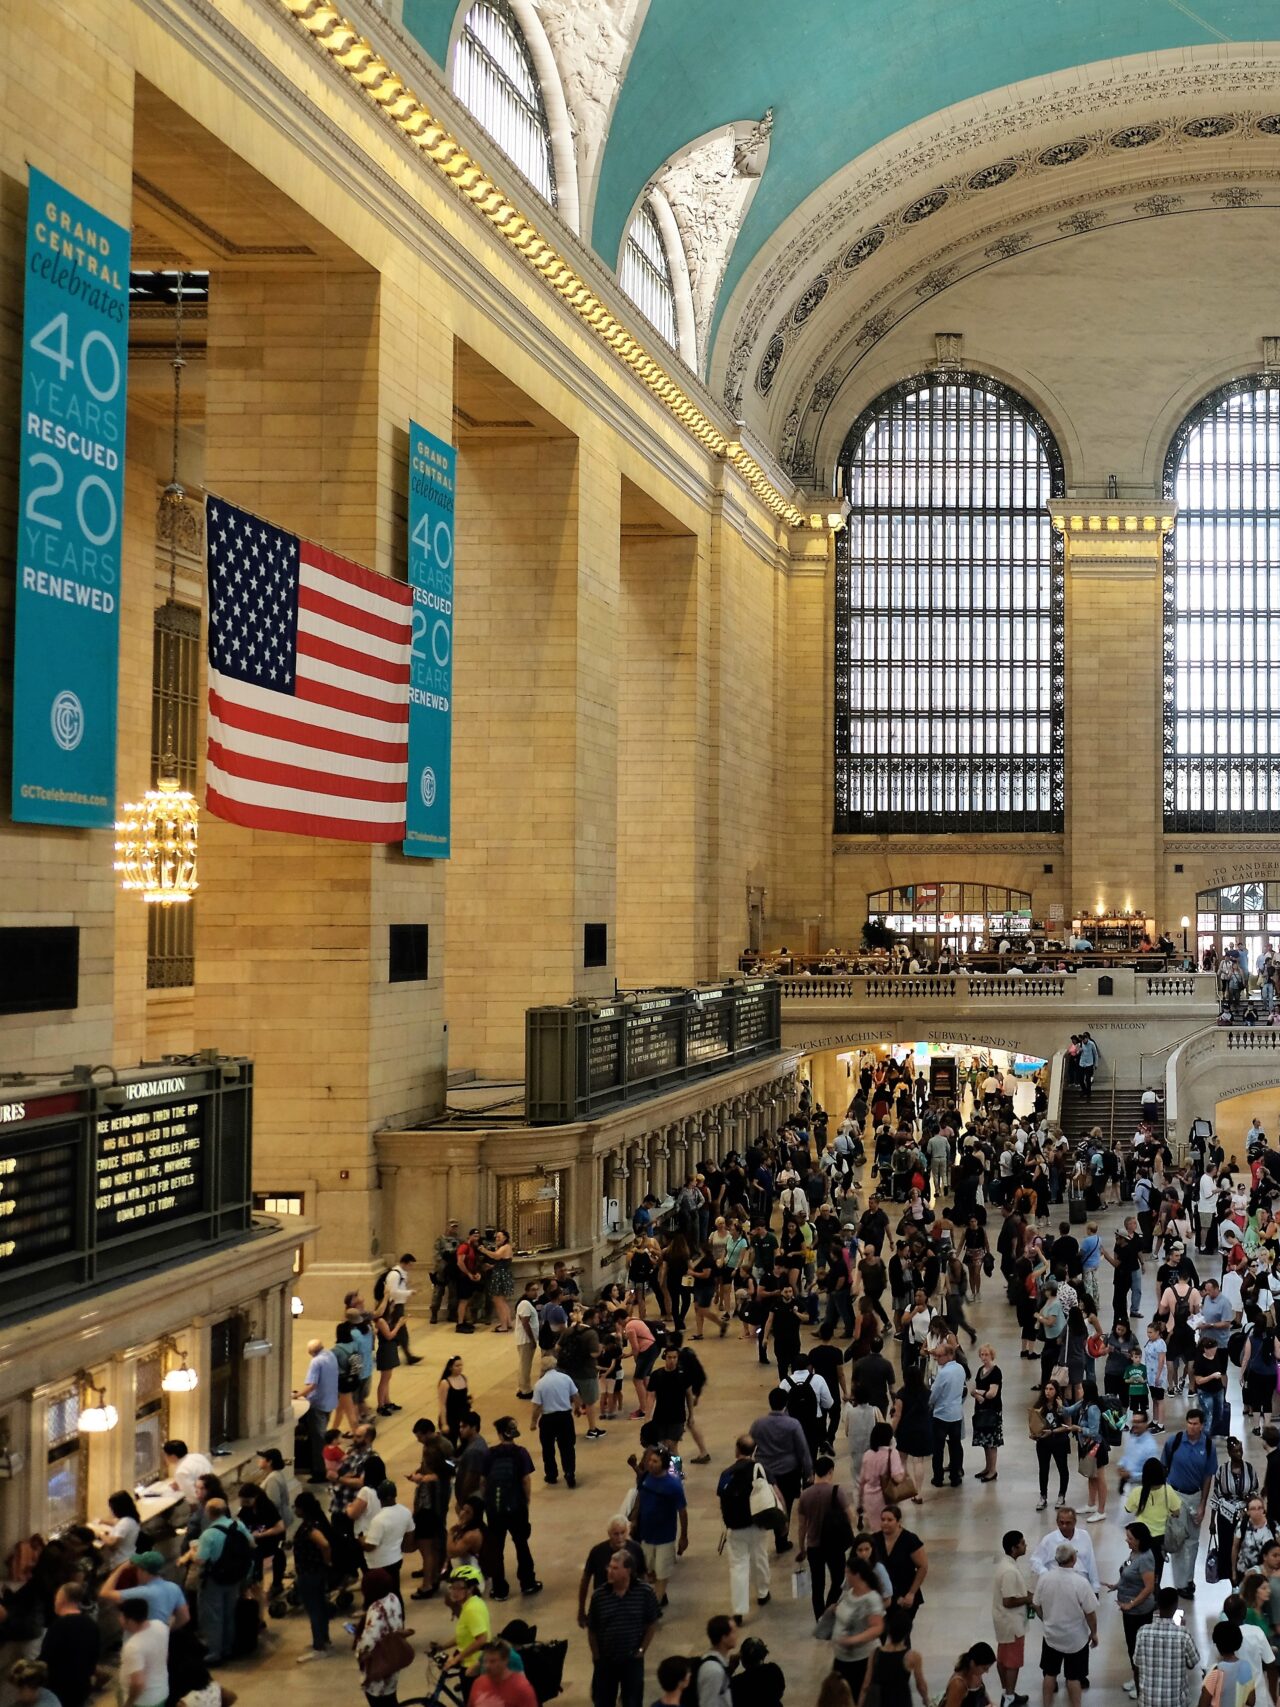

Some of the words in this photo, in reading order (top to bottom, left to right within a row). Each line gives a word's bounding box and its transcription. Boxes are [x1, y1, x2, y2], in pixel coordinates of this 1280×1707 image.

[45, 202, 110, 257] GRAND
[35, 222, 122, 290] CENTRAL
[30, 250, 124, 323] celebrates
[29, 312, 120, 402] 40
[30, 372, 117, 442] YEARS
[27, 411, 118, 471] RESCUED
[417, 442, 448, 470] GRAND
[411, 472, 454, 513] celebrates
[413, 457, 452, 490] CENTRAL
[26, 452, 117, 546] 20
[26, 526, 115, 585] YEARS
[411, 512, 452, 570] 40
[23, 566, 114, 614] RENEWED
[411, 556, 451, 595] YEARS
[412, 610, 450, 667] 20
[411, 663, 449, 692] YEARS
[409, 687, 449, 712] RENEWED
[20, 784, 107, 807] GCTcelebrates.com
[1207, 876, 1226, 886] THE
[1213, 867, 1227, 876] TO
[835, 1030, 893, 1044] MACHINES
[928, 1031, 972, 1042] SUBWAY
[979, 1035, 1006, 1047] 42ND
[1008, 1040, 1021, 1049] ST
[1110, 1022, 1147, 1030] BALCONY
[1219, 1084, 1246, 1098] DINING
[111, 1113, 150, 1131] METRO-NORTH
